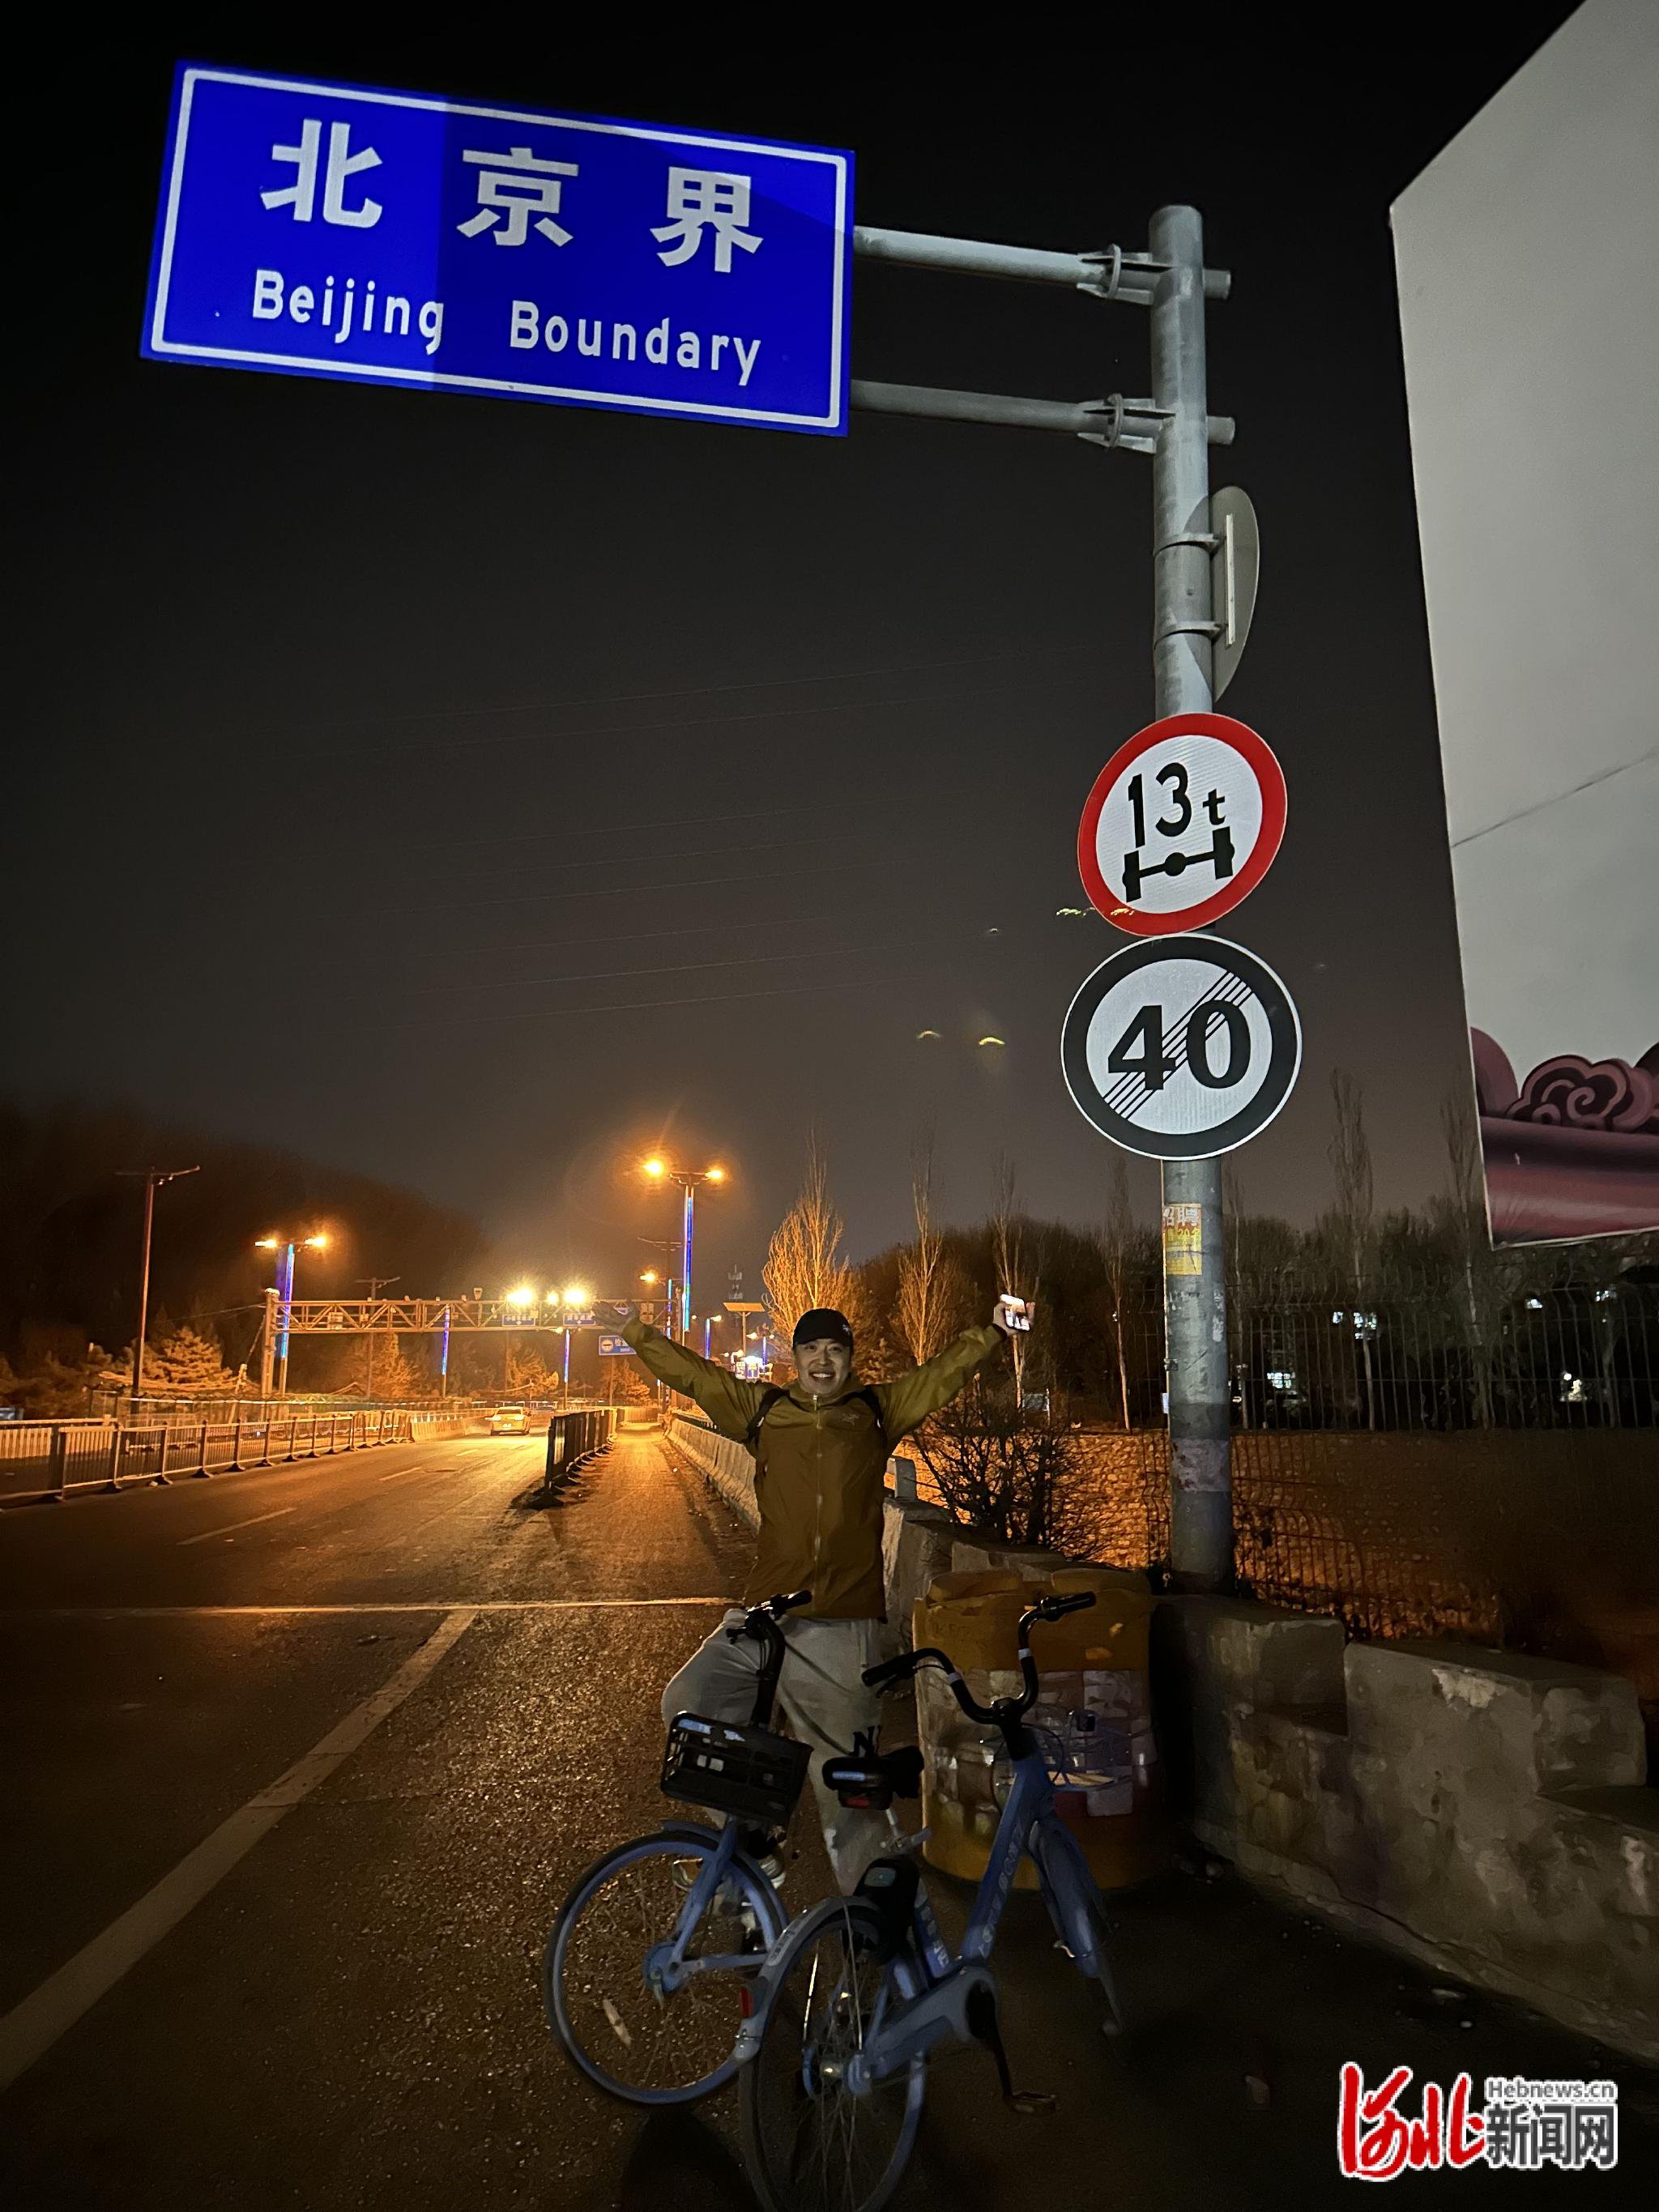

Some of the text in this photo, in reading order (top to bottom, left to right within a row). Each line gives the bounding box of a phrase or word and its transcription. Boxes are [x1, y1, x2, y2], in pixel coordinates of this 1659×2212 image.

[259, 117, 764, 274] 北京界
[252, 269, 761, 386] Beijing Boundary
[1127, 762, 1226, 848] 13t
[1107, 999, 1252, 1090] 40
